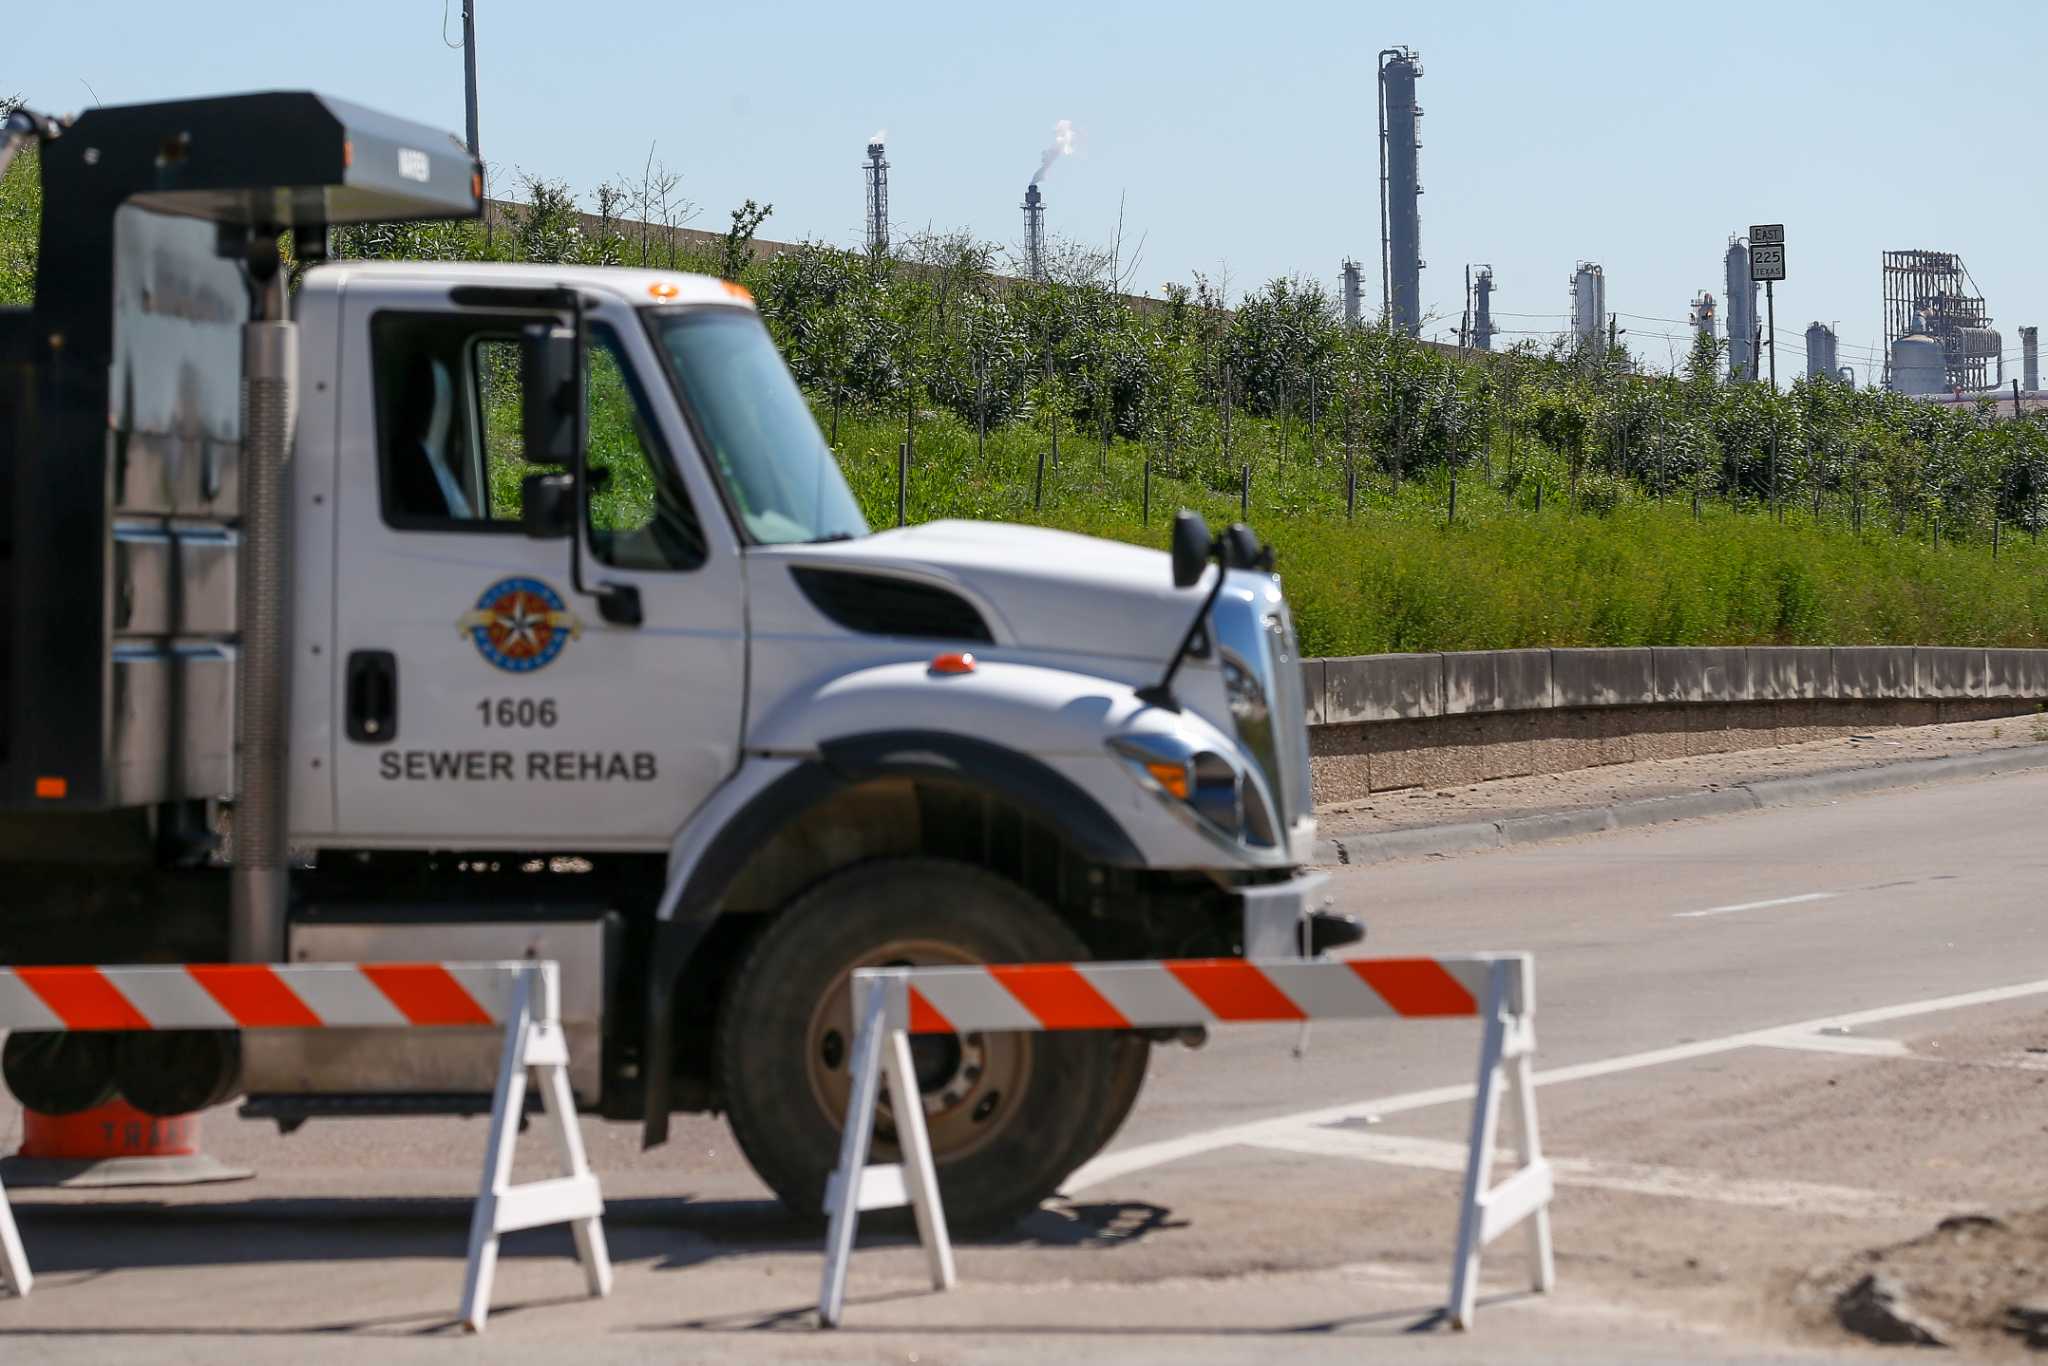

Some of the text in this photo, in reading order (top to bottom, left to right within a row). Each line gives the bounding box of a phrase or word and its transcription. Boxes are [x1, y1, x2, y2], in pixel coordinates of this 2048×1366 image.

[1755, 228, 1779, 241] EAST
[1755, 251, 1780, 263] 225
[1754, 267, 1781, 276] TEXAS
[475, 697, 559, 728] 1606
[379, 750, 658, 781] SEWER REHAB
